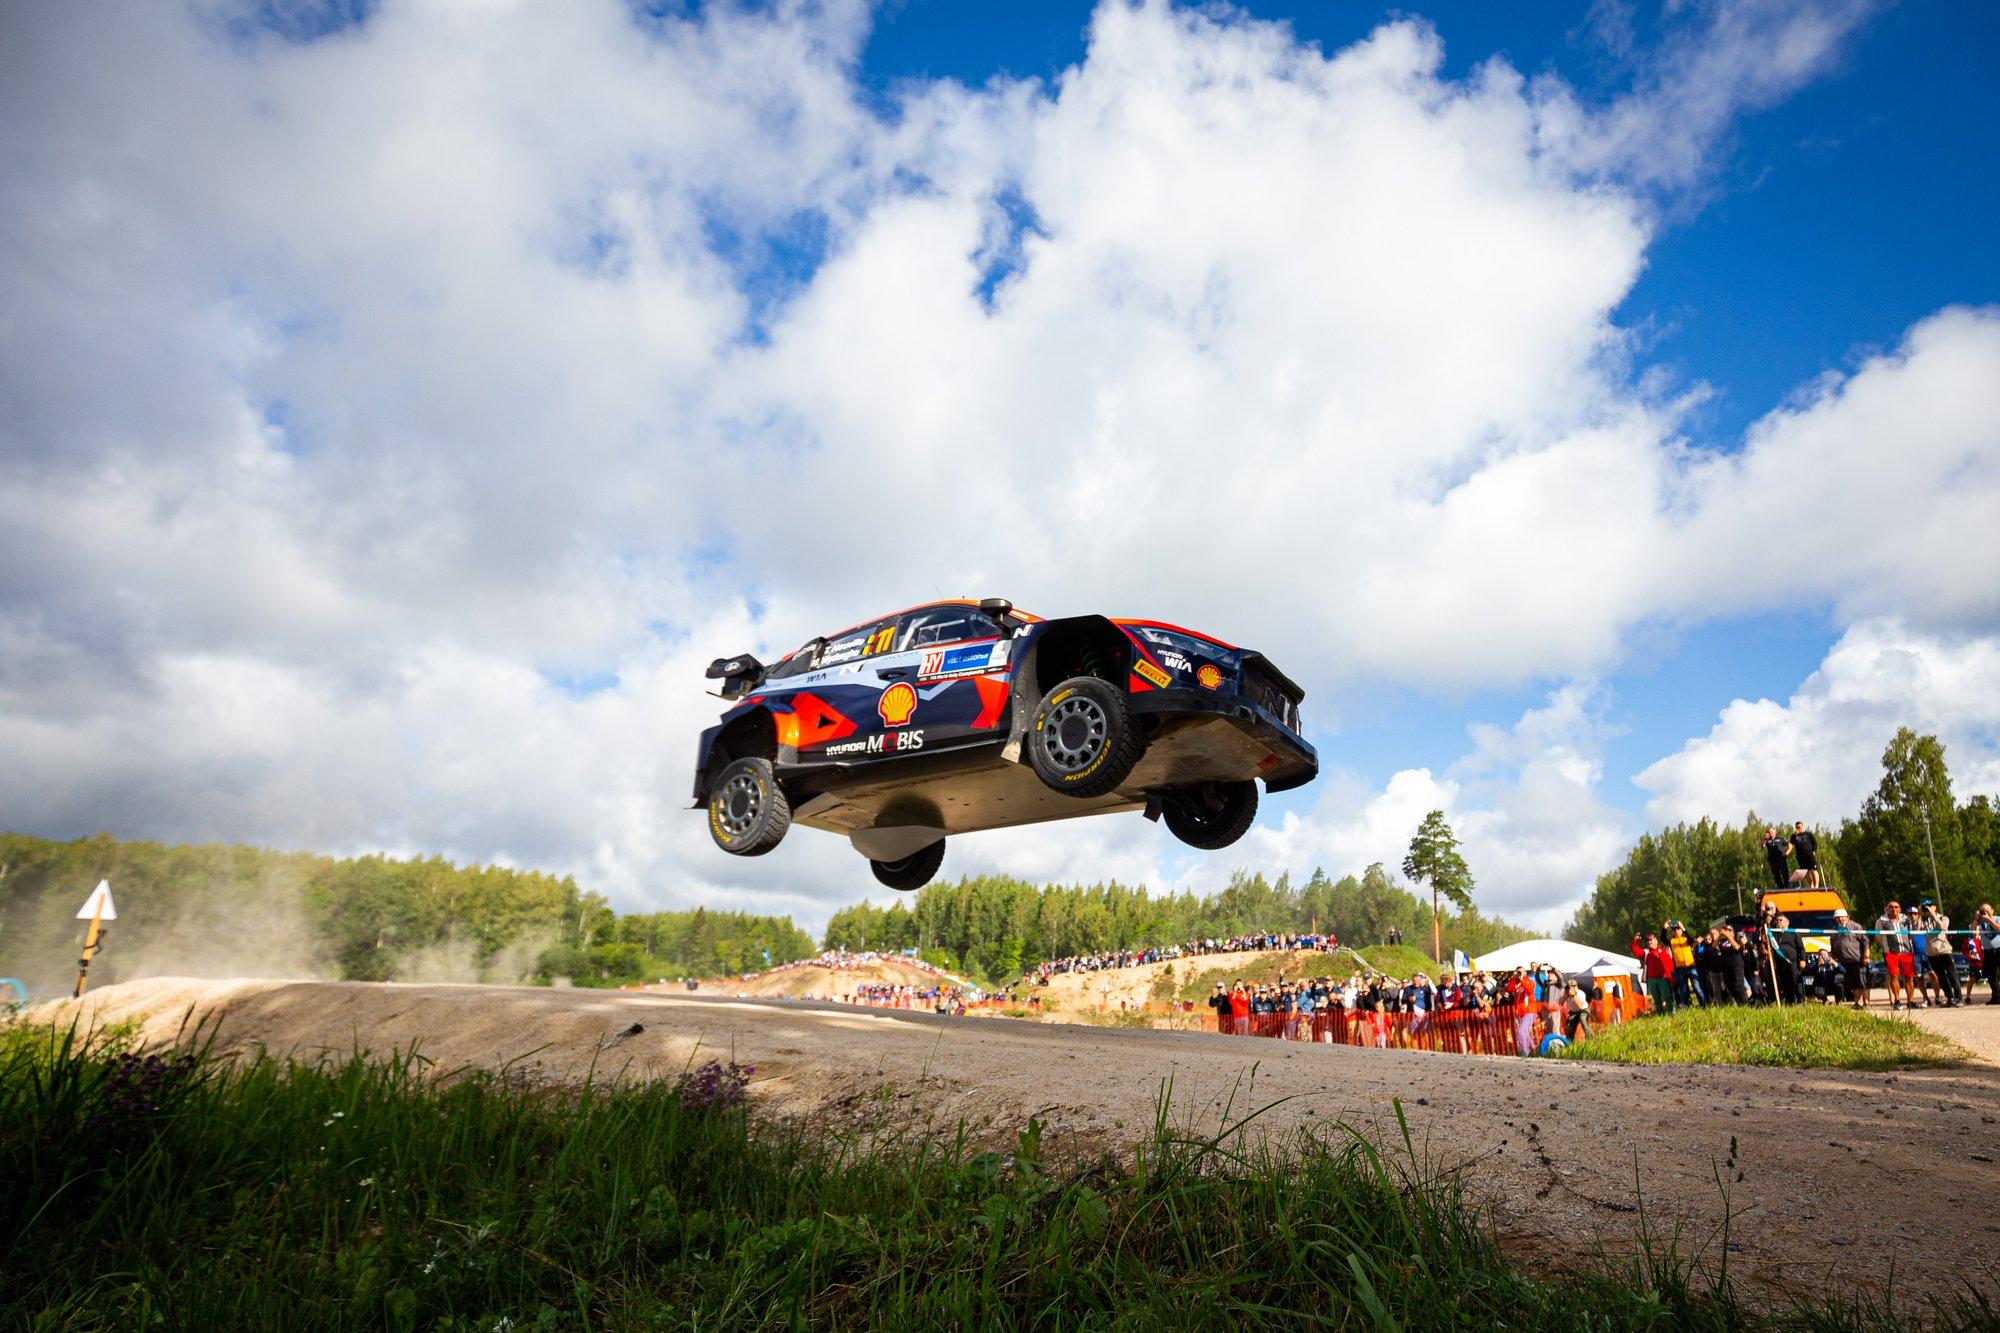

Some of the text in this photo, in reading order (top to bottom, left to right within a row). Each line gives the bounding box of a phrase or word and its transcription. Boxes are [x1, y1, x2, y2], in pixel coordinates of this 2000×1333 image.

[875, 627, 896, 653] 11
[826, 730, 924, 756] HYUNDAI MOBIS
[1063, 738, 1111, 781] SCORPION
